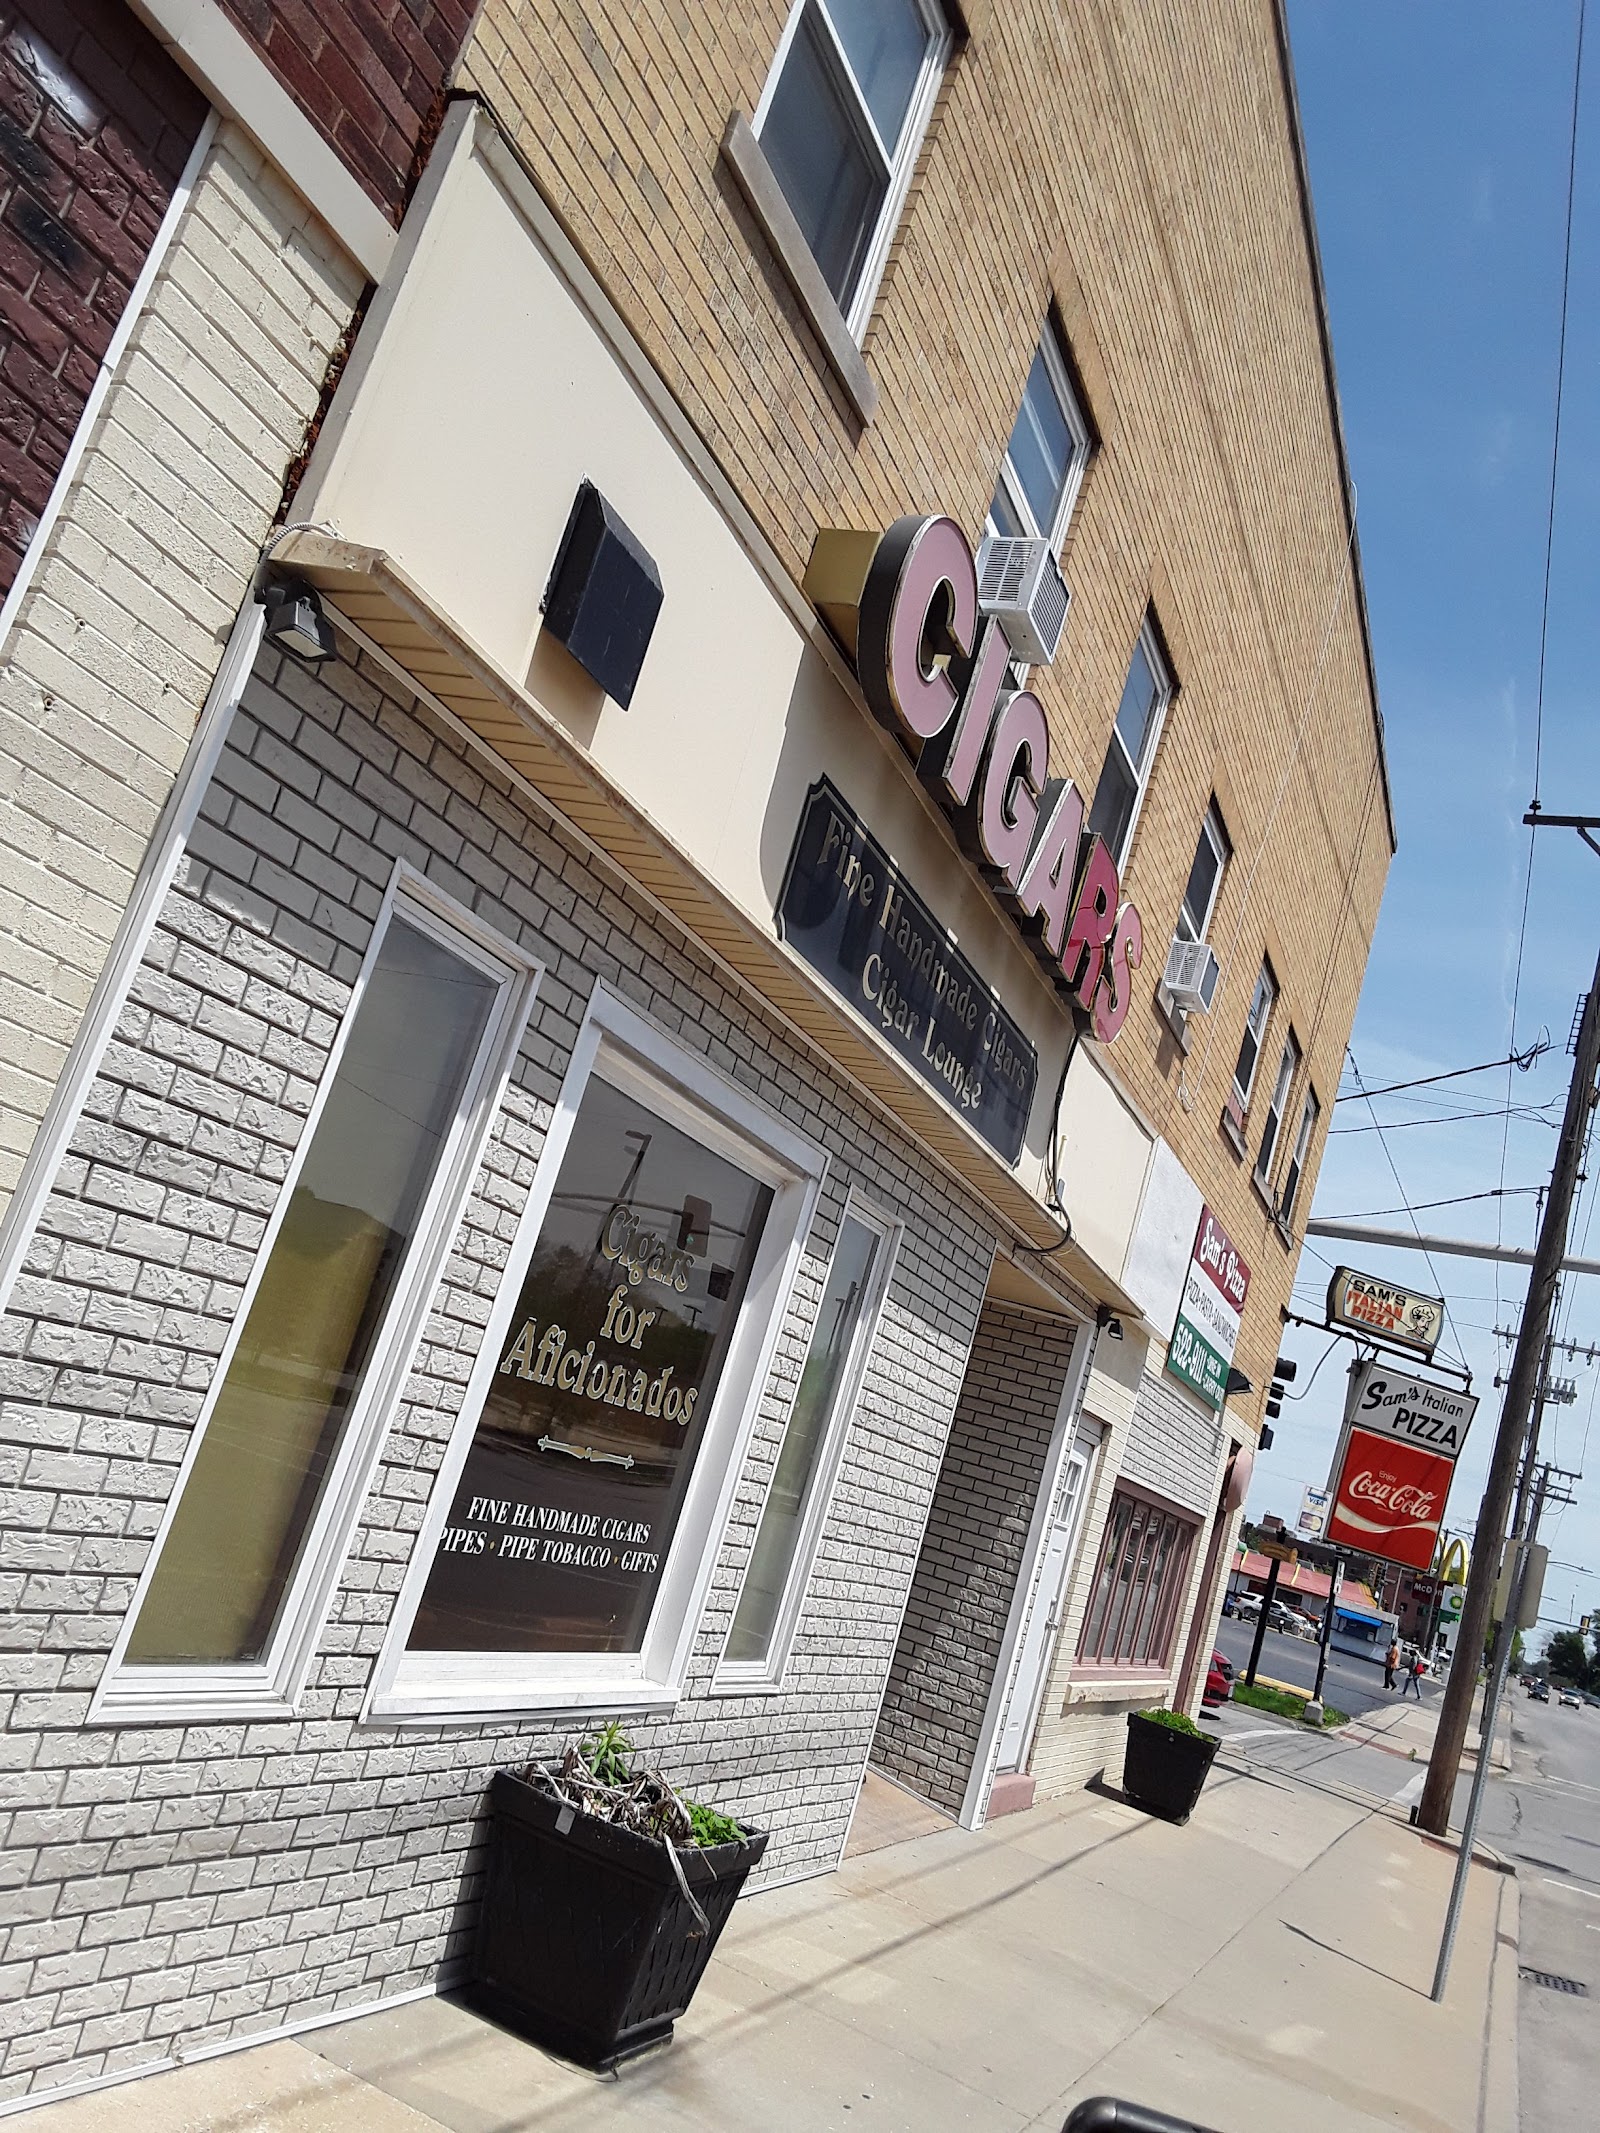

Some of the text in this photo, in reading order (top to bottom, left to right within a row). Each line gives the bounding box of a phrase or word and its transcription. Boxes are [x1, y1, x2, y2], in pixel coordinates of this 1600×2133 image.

[887, 513, 1142, 1044] CIGARS
[816, 810, 1028, 1091] Fine Handmade Cigars
[861, 953, 983, 1110] Cigar Lounge
[601, 1204, 696, 1294] Cigars
[1200, 1217, 1246, 1303] Sam's Pizza
[599, 1284, 655, 1350] for
[1346, 1290, 1404, 1320] ITALIAN
[1350, 1305, 1395, 1331] PIZZA
[1352, 1279, 1407, 1308] SAM'S
[499, 1315, 699, 1427] Aficionados
[1361, 1380, 1464, 1418] Sam's Italian
[1392, 1407, 1458, 1449] PIZZA
[1348, 1470, 1439, 1520] Coca-Cola
[1378, 1470, 1398, 1484] Enjoy
[466, 1496, 652, 1545] FINE HANDMADE CIGARS
[1309, 1497, 1324, 1508] VISA
[497, 1534, 540, 1561] PIPE
[541, 1540, 612, 1568] TOBACCO
[620, 1550, 661, 1574] GIFTS
